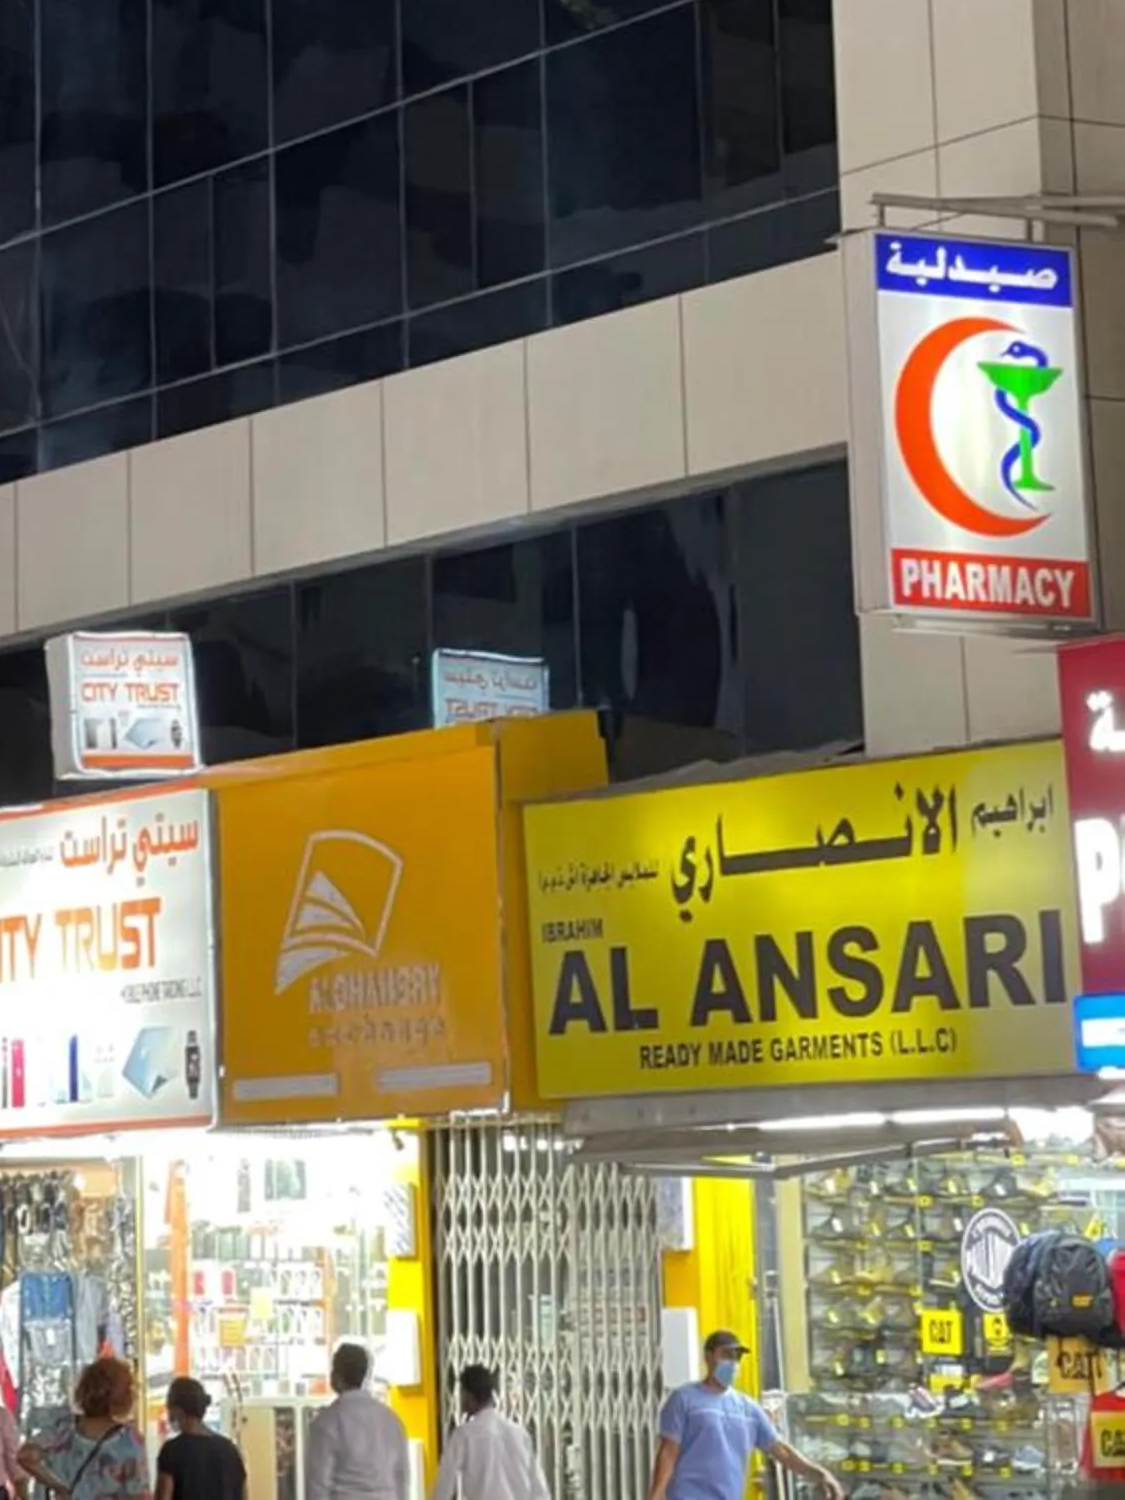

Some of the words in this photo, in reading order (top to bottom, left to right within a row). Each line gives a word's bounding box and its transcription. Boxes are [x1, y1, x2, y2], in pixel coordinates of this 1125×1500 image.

[885, 241, 1060, 293] صيدلية
[900, 556, 1075, 609] PHARMACY
[81, 681, 118, 703] CITY
[124, 681, 180, 704] TRUST
[60, 815, 128, 876] تراست
[133, 813, 200, 887] سيتي
[55, 897, 162, 974] TRUST
[540, 918, 604, 943] IBRAHIM
[549, 946, 660, 1037] AL
[689, 908, 1067, 1028] ANSARI
[639, 1039, 701, 1071] READY
[708, 1037, 766, 1065] MADE
[769, 1030, 884, 1063] GARMENTS
[928, 1319, 954, 1345] CAT
[1057, 1351, 1105, 1381] CAT
[1100, 1429, 1125, 1458] CA
